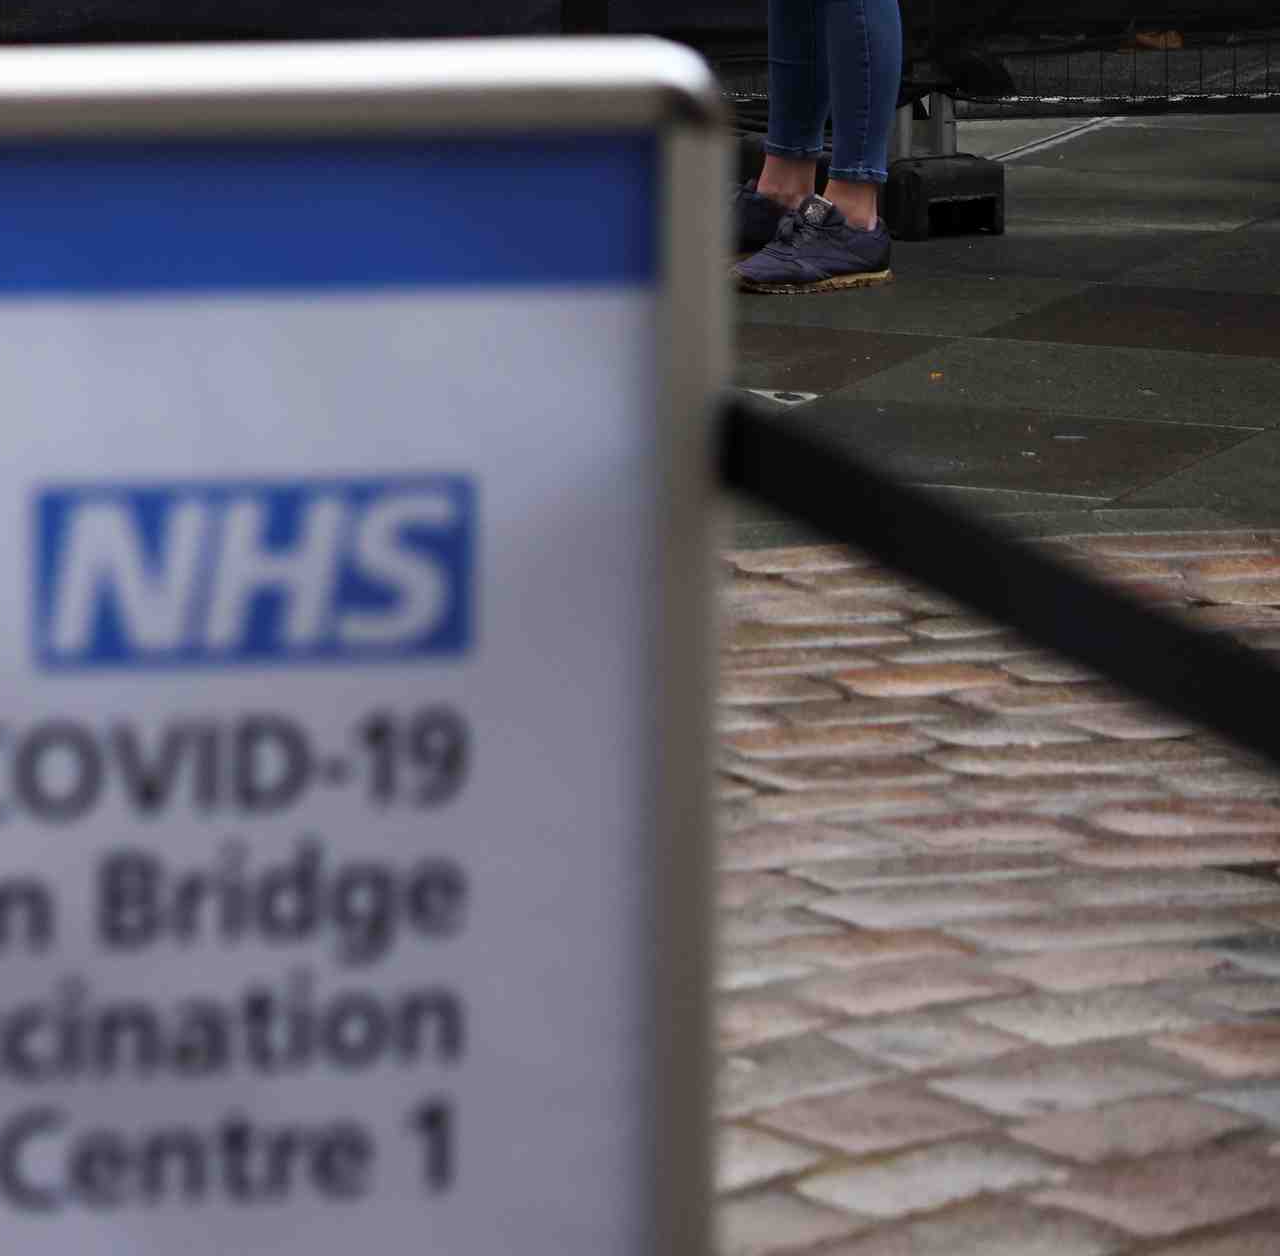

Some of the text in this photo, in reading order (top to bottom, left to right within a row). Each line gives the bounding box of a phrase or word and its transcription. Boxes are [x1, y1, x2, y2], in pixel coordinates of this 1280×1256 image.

[48, 494, 460, 658] NHS
[94, 834, 469, 967] Bridge
[407, 1093, 456, 1196] 1
